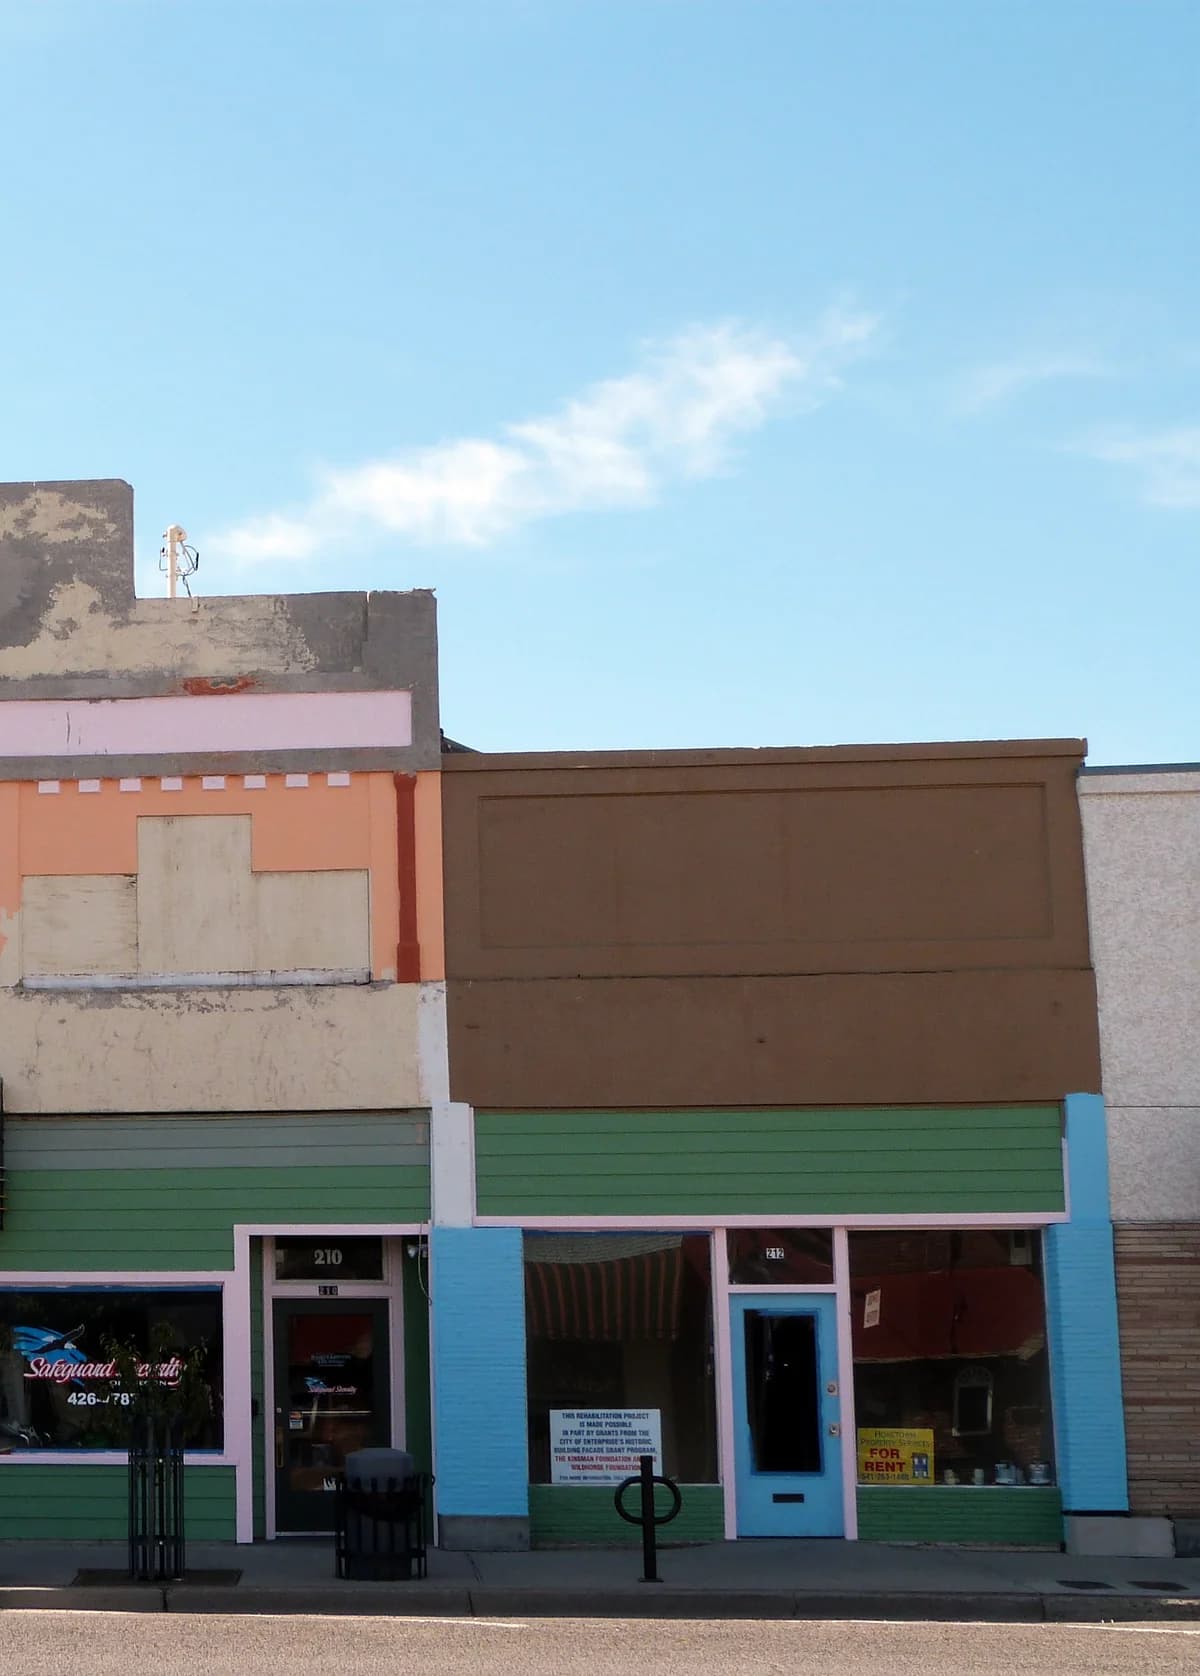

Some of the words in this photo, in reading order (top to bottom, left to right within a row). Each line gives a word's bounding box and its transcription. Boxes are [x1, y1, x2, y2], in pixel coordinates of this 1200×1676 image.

[313, 1248, 343, 1265] 210
[766, 1248, 784, 1259] 212
[23, 1357, 117, 1383] Safeguard
[869, 1448, 900, 1459] FOR
[864, 1461, 906, 1472] RENT
